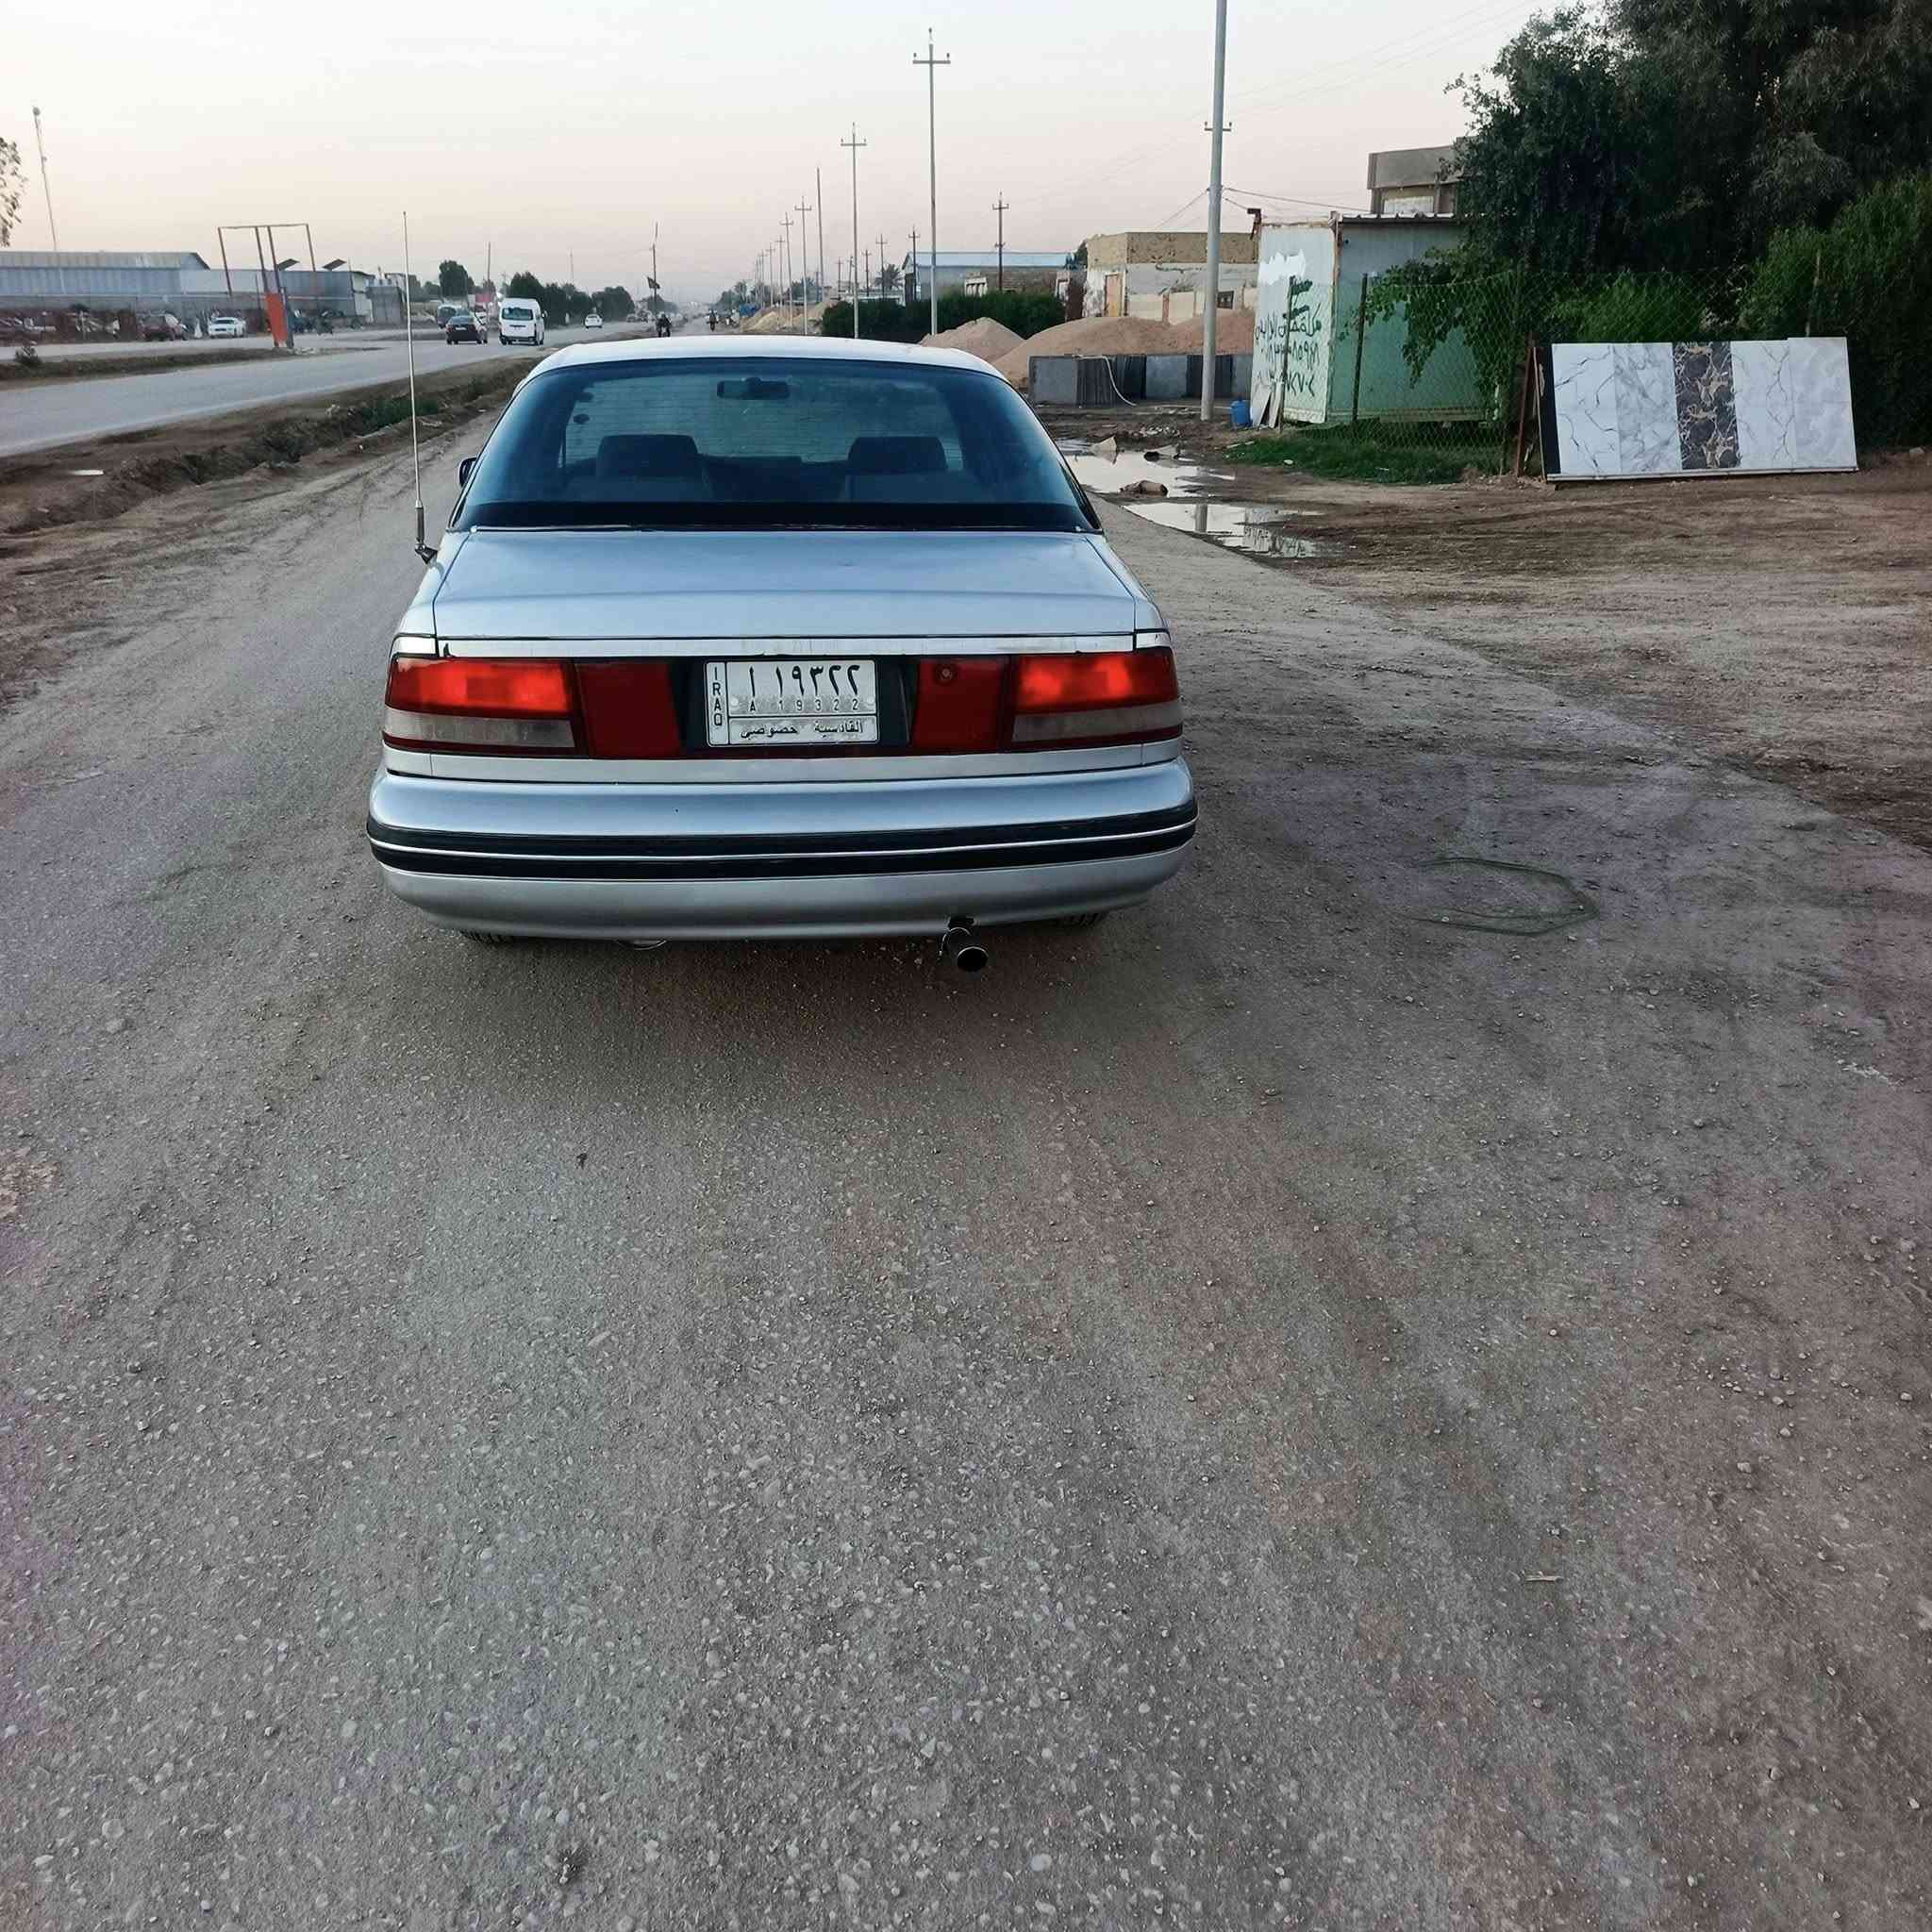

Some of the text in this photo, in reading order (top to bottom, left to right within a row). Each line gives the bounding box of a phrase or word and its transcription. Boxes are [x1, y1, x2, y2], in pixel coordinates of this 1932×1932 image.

[711, 666, 723, 726] IRAQ
[749, 698, 859, 712] A 19322
[741, 720, 863, 740] القادسية خصوصي
